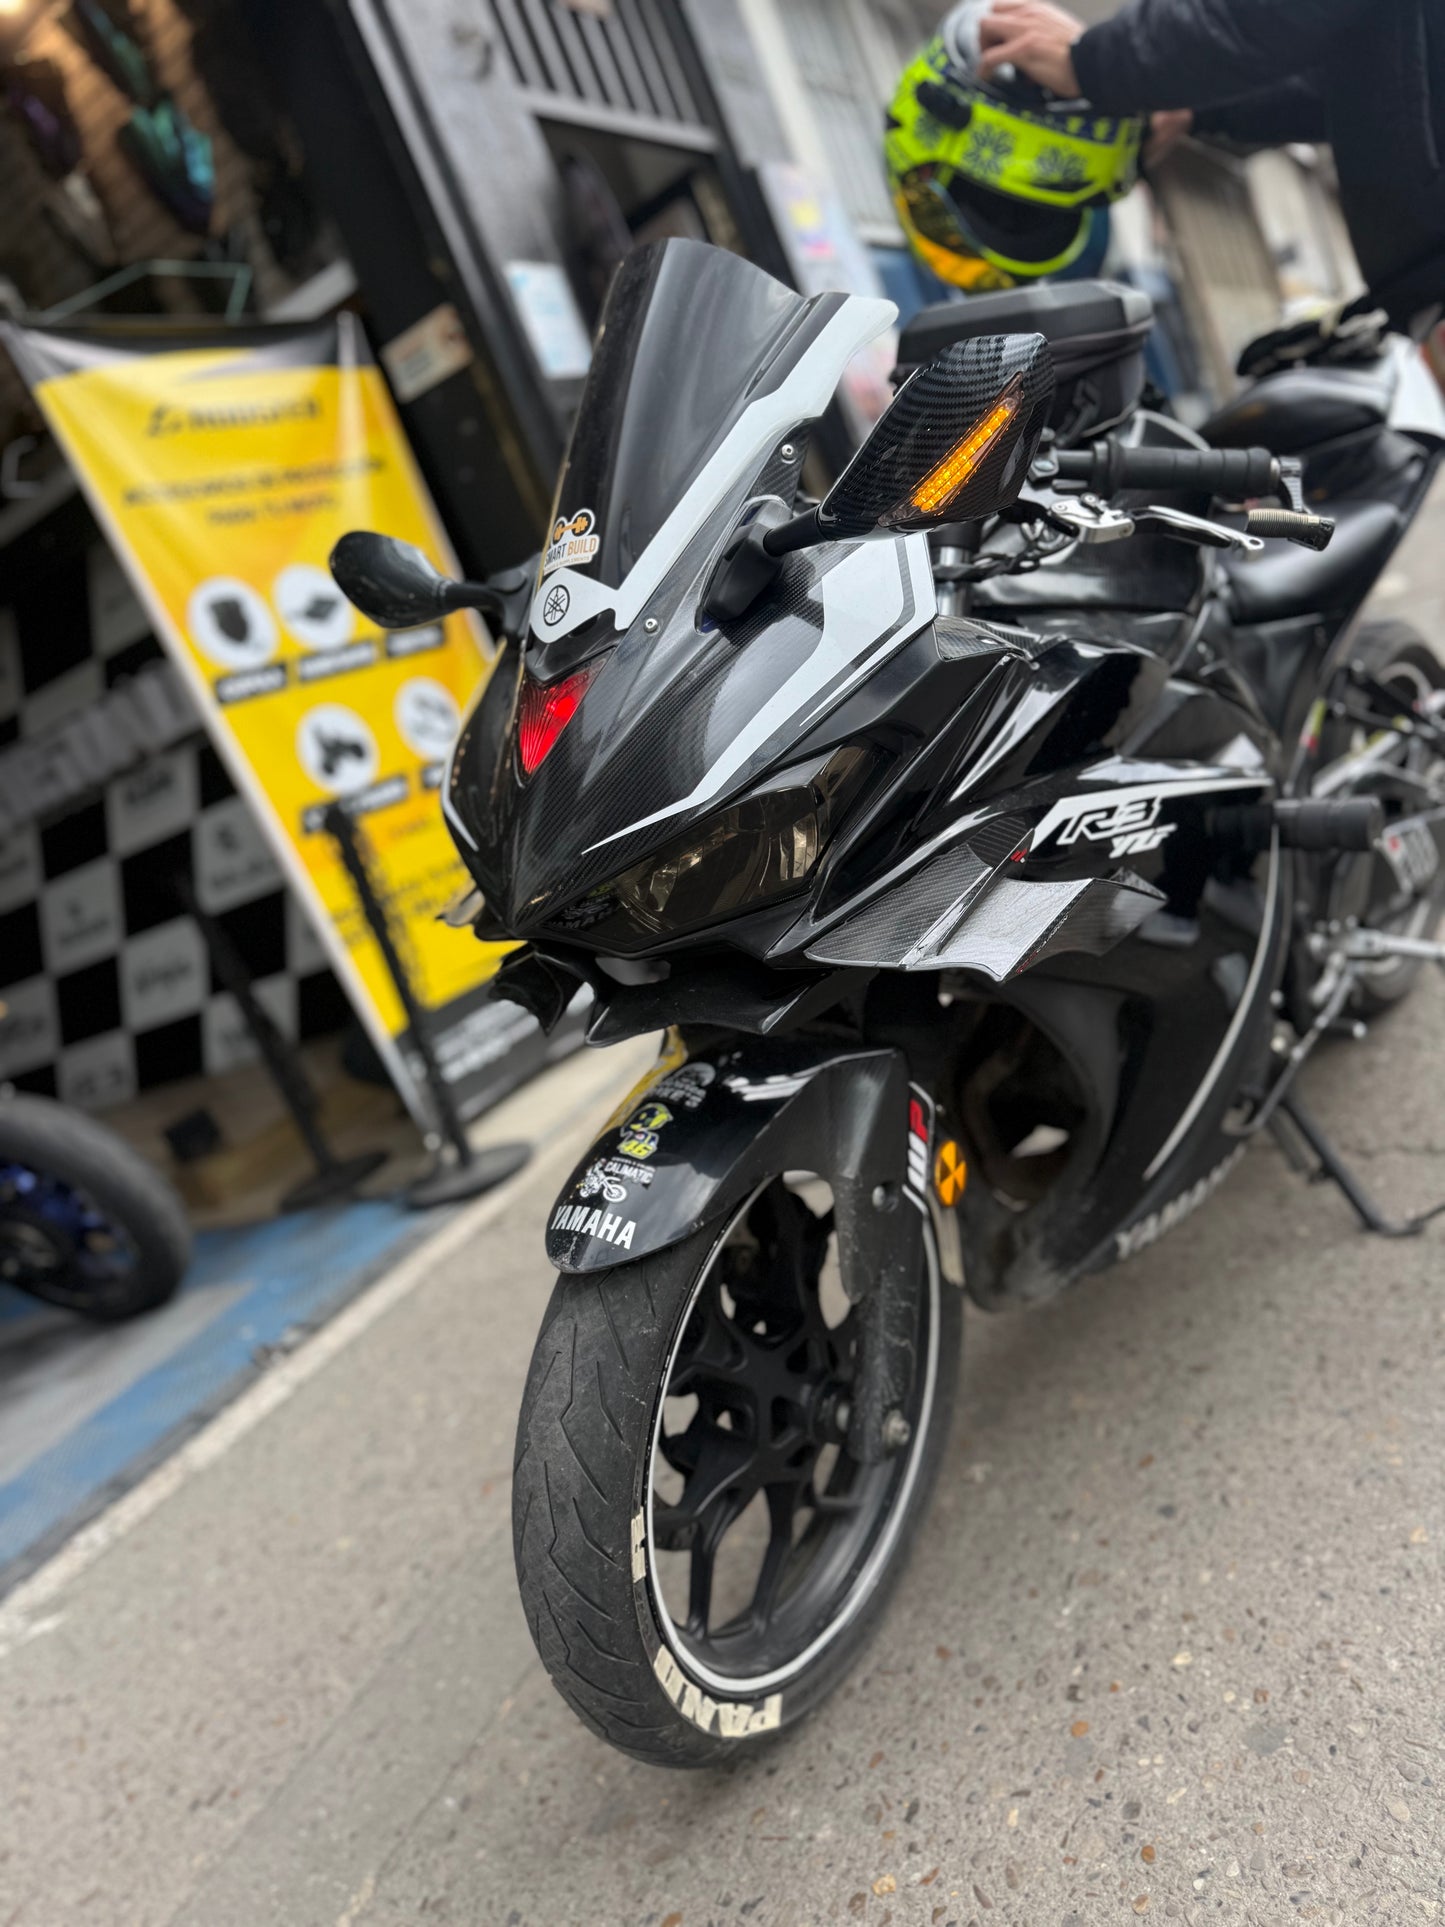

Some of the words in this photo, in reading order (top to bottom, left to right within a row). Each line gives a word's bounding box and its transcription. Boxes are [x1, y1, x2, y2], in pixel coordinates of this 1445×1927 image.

[545, 542, 567, 568] SMART
[568, 538, 597, 556] BUILD
[1056, 796, 1163, 846] R3
[620, 1138, 654, 1157] 46
[604, 1161, 654, 1184] CALIMATIC
[551, 1205, 637, 1250] YAMAHA
